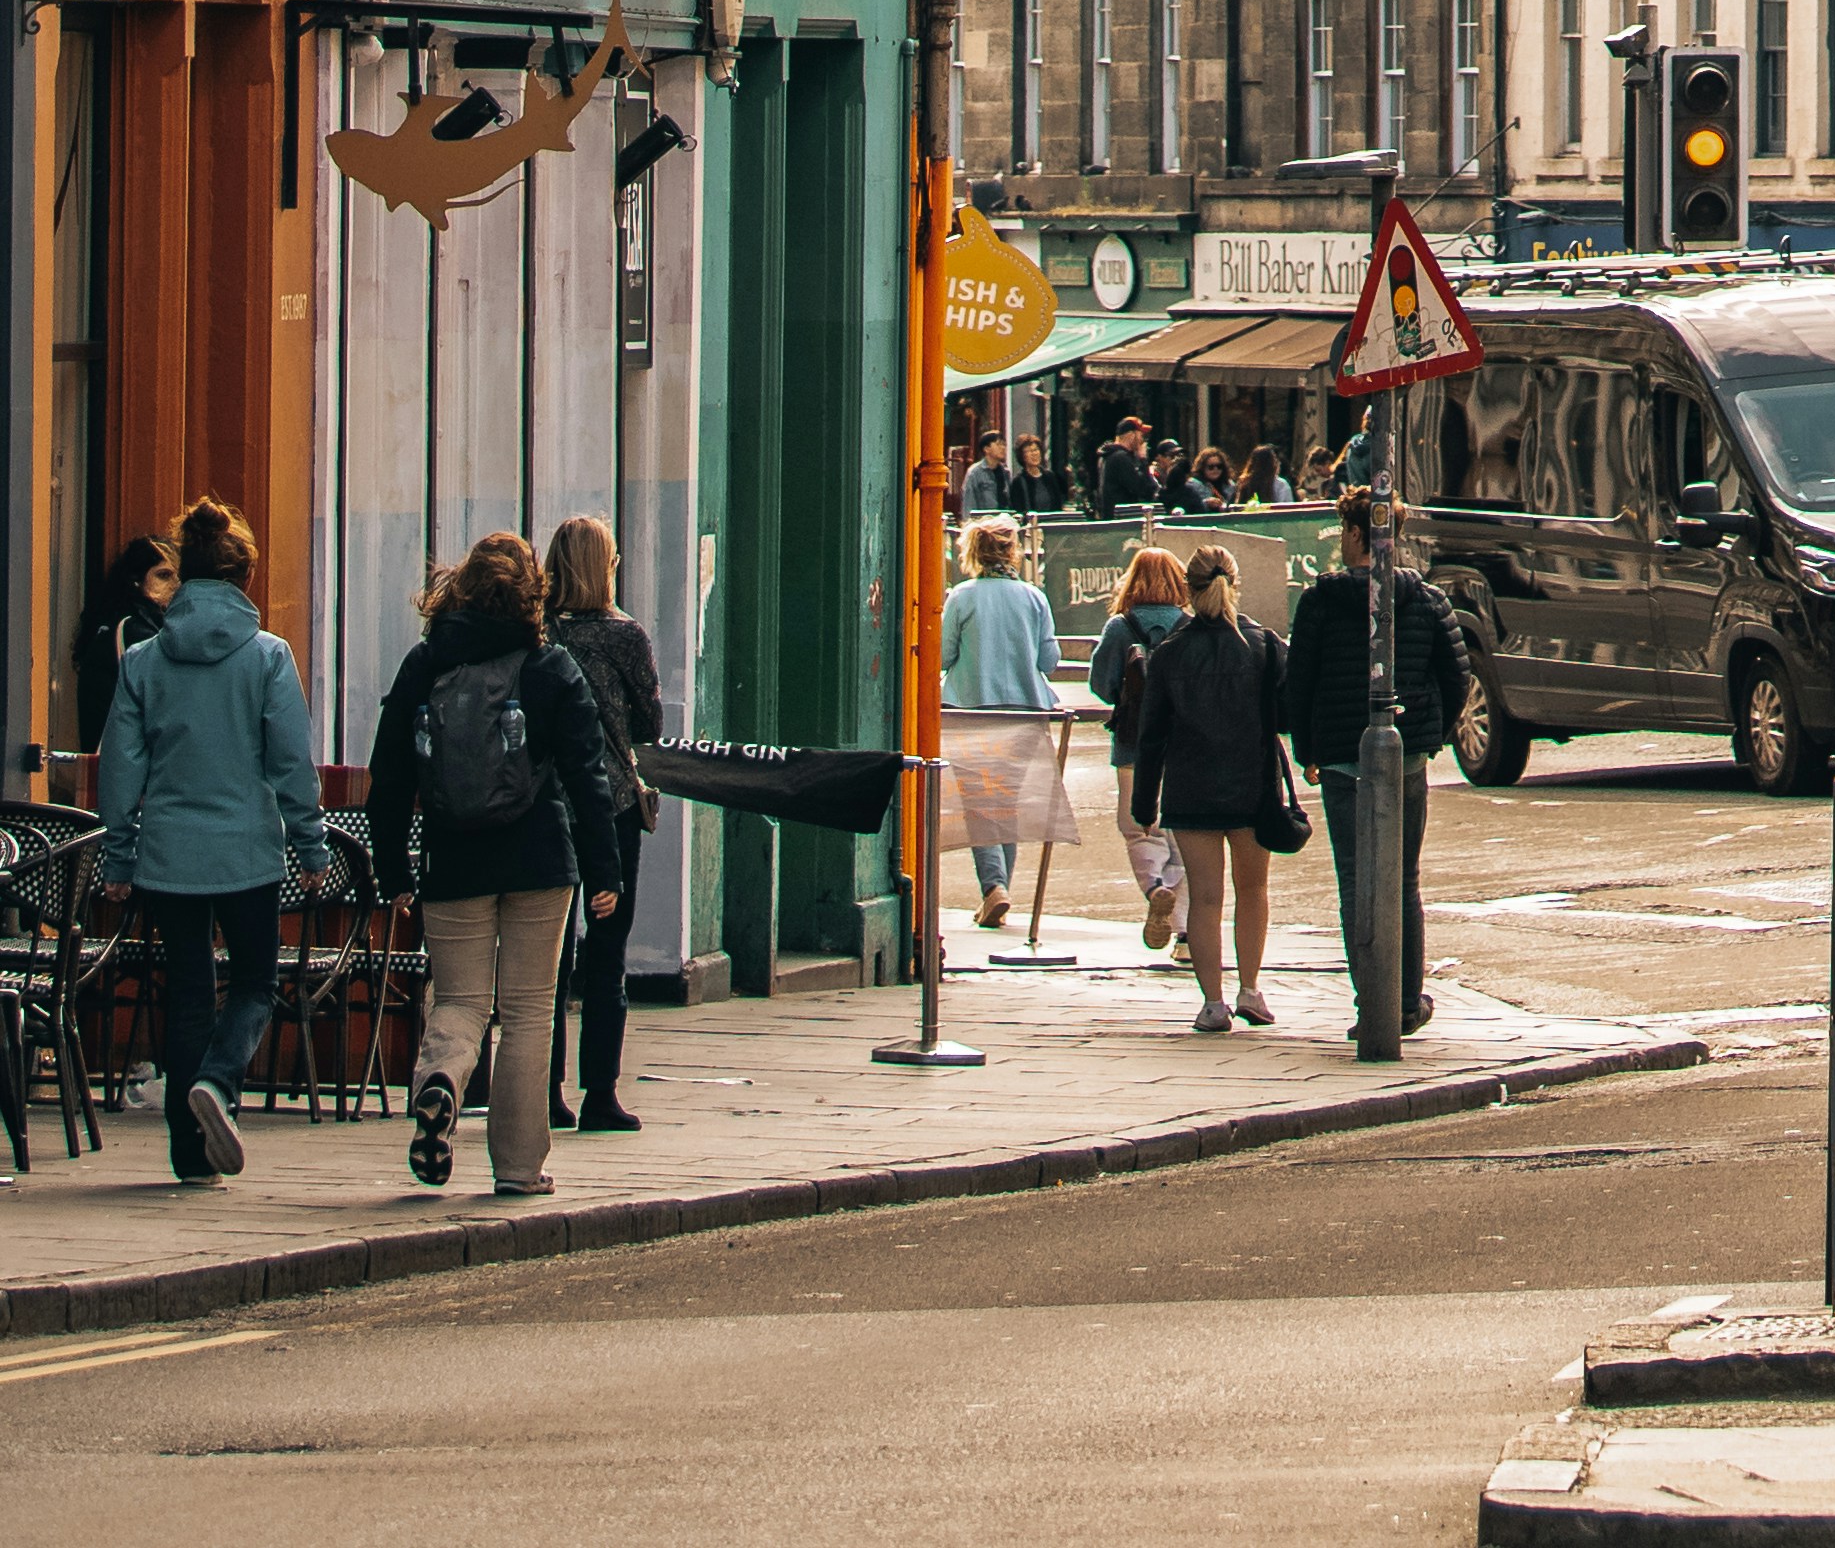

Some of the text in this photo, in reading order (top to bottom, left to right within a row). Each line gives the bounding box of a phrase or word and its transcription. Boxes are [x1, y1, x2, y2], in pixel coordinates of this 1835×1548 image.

[1219, 240, 1252, 293] Bill
[1258, 239, 1315, 294] Baber
[945, 277, 1025, 309] ISH &
[945, 304, 1014, 335] HIPS
[658, 737, 789, 762] URGH GIN
